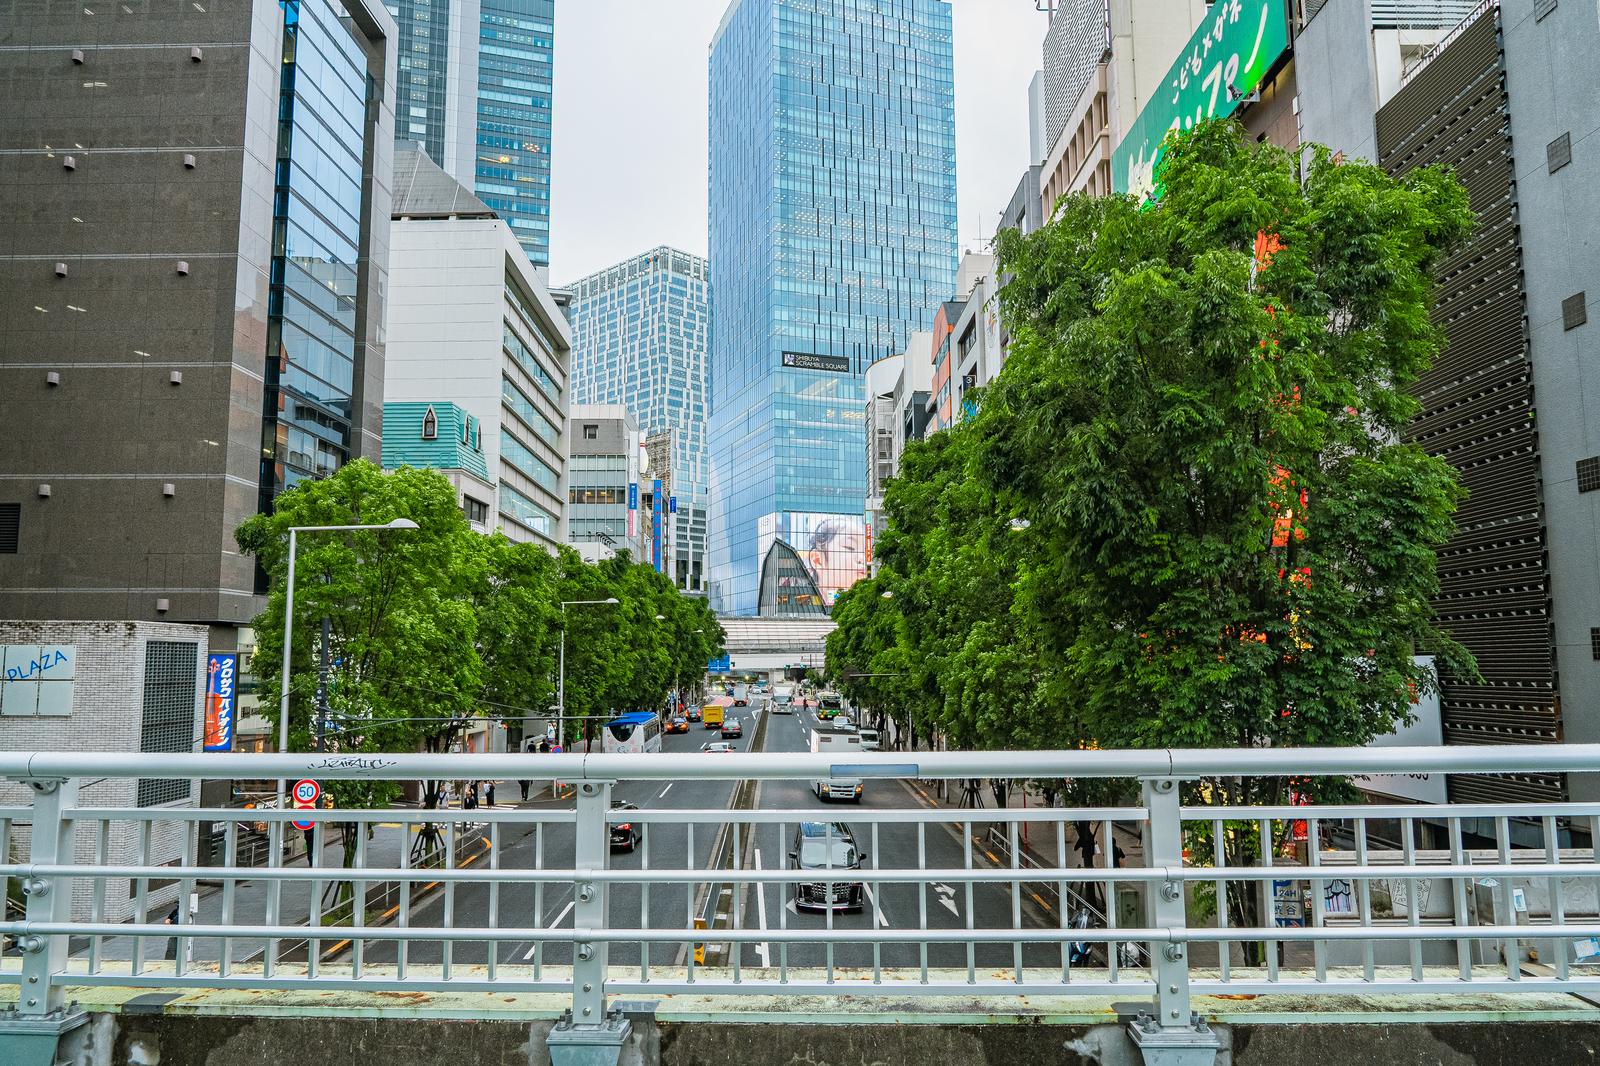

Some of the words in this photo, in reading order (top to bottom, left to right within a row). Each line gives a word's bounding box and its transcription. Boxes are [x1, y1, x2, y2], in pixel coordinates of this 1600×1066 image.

[795, 354, 820, 363] SHIBUYA
[795, 360, 825, 370] SCRAMBLE
[825, 362, 848, 372] SQUARE
[7, 650, 68, 683] PLAZA
[216, 658, 234, 746] クロサワバイオリン
[298, 786, 314, 798] 50
[1279, 889, 1297, 898] 24H
